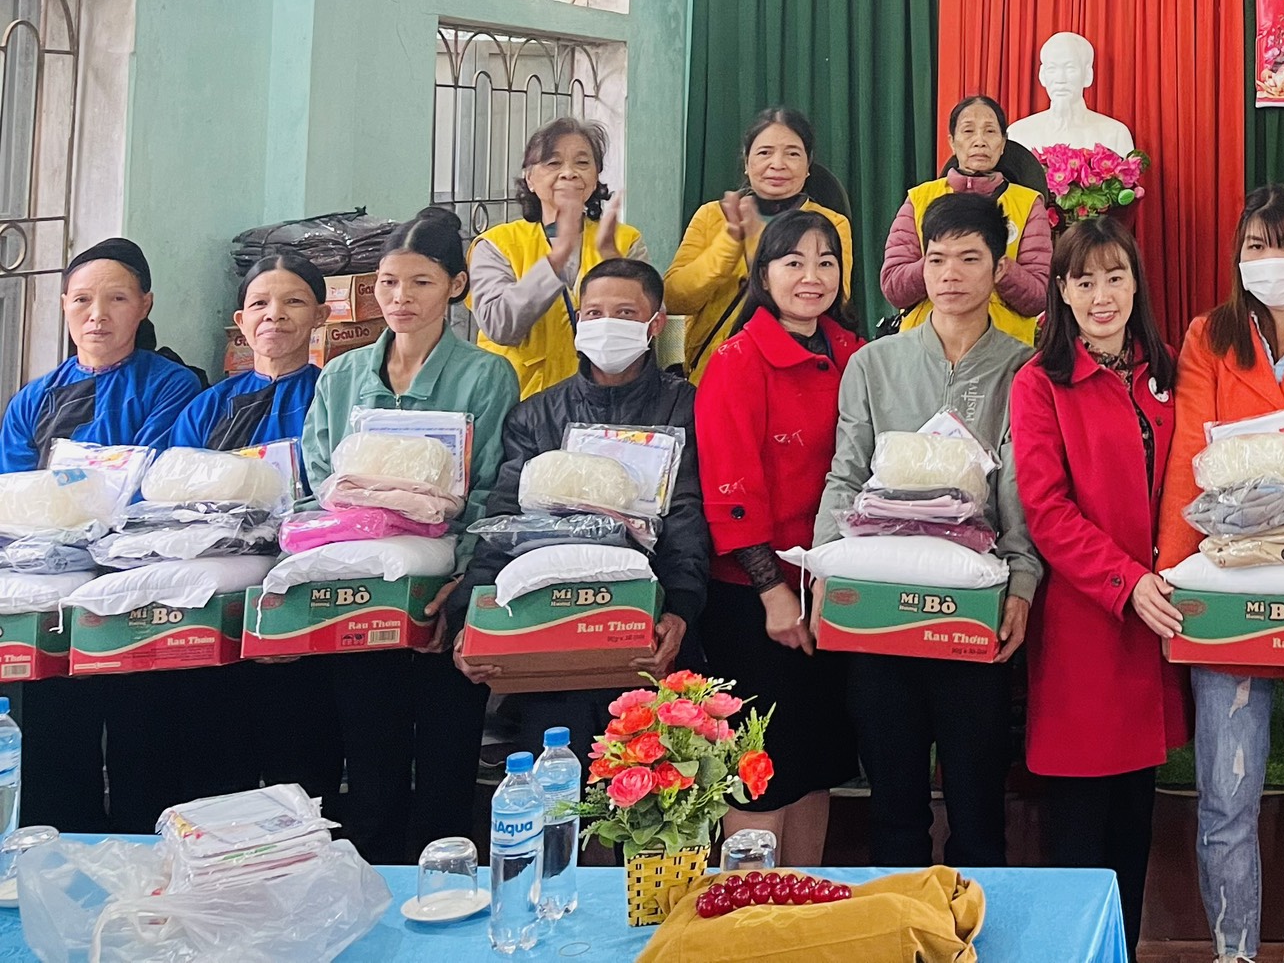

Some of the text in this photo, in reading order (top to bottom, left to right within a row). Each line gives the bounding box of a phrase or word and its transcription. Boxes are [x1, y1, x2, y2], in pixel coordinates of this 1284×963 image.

[336, 587, 371, 606] Bò
[576, 588, 612, 606] Bò
[901, 593, 919, 605] Mì
[923, 595, 957, 614] Bò
[1246, 601, 1265, 613] Mì
[348, 621, 369, 630] Rau
[577, 621, 646, 633] Rau Thơm
[923, 630, 989, 645] Rau Thơm
